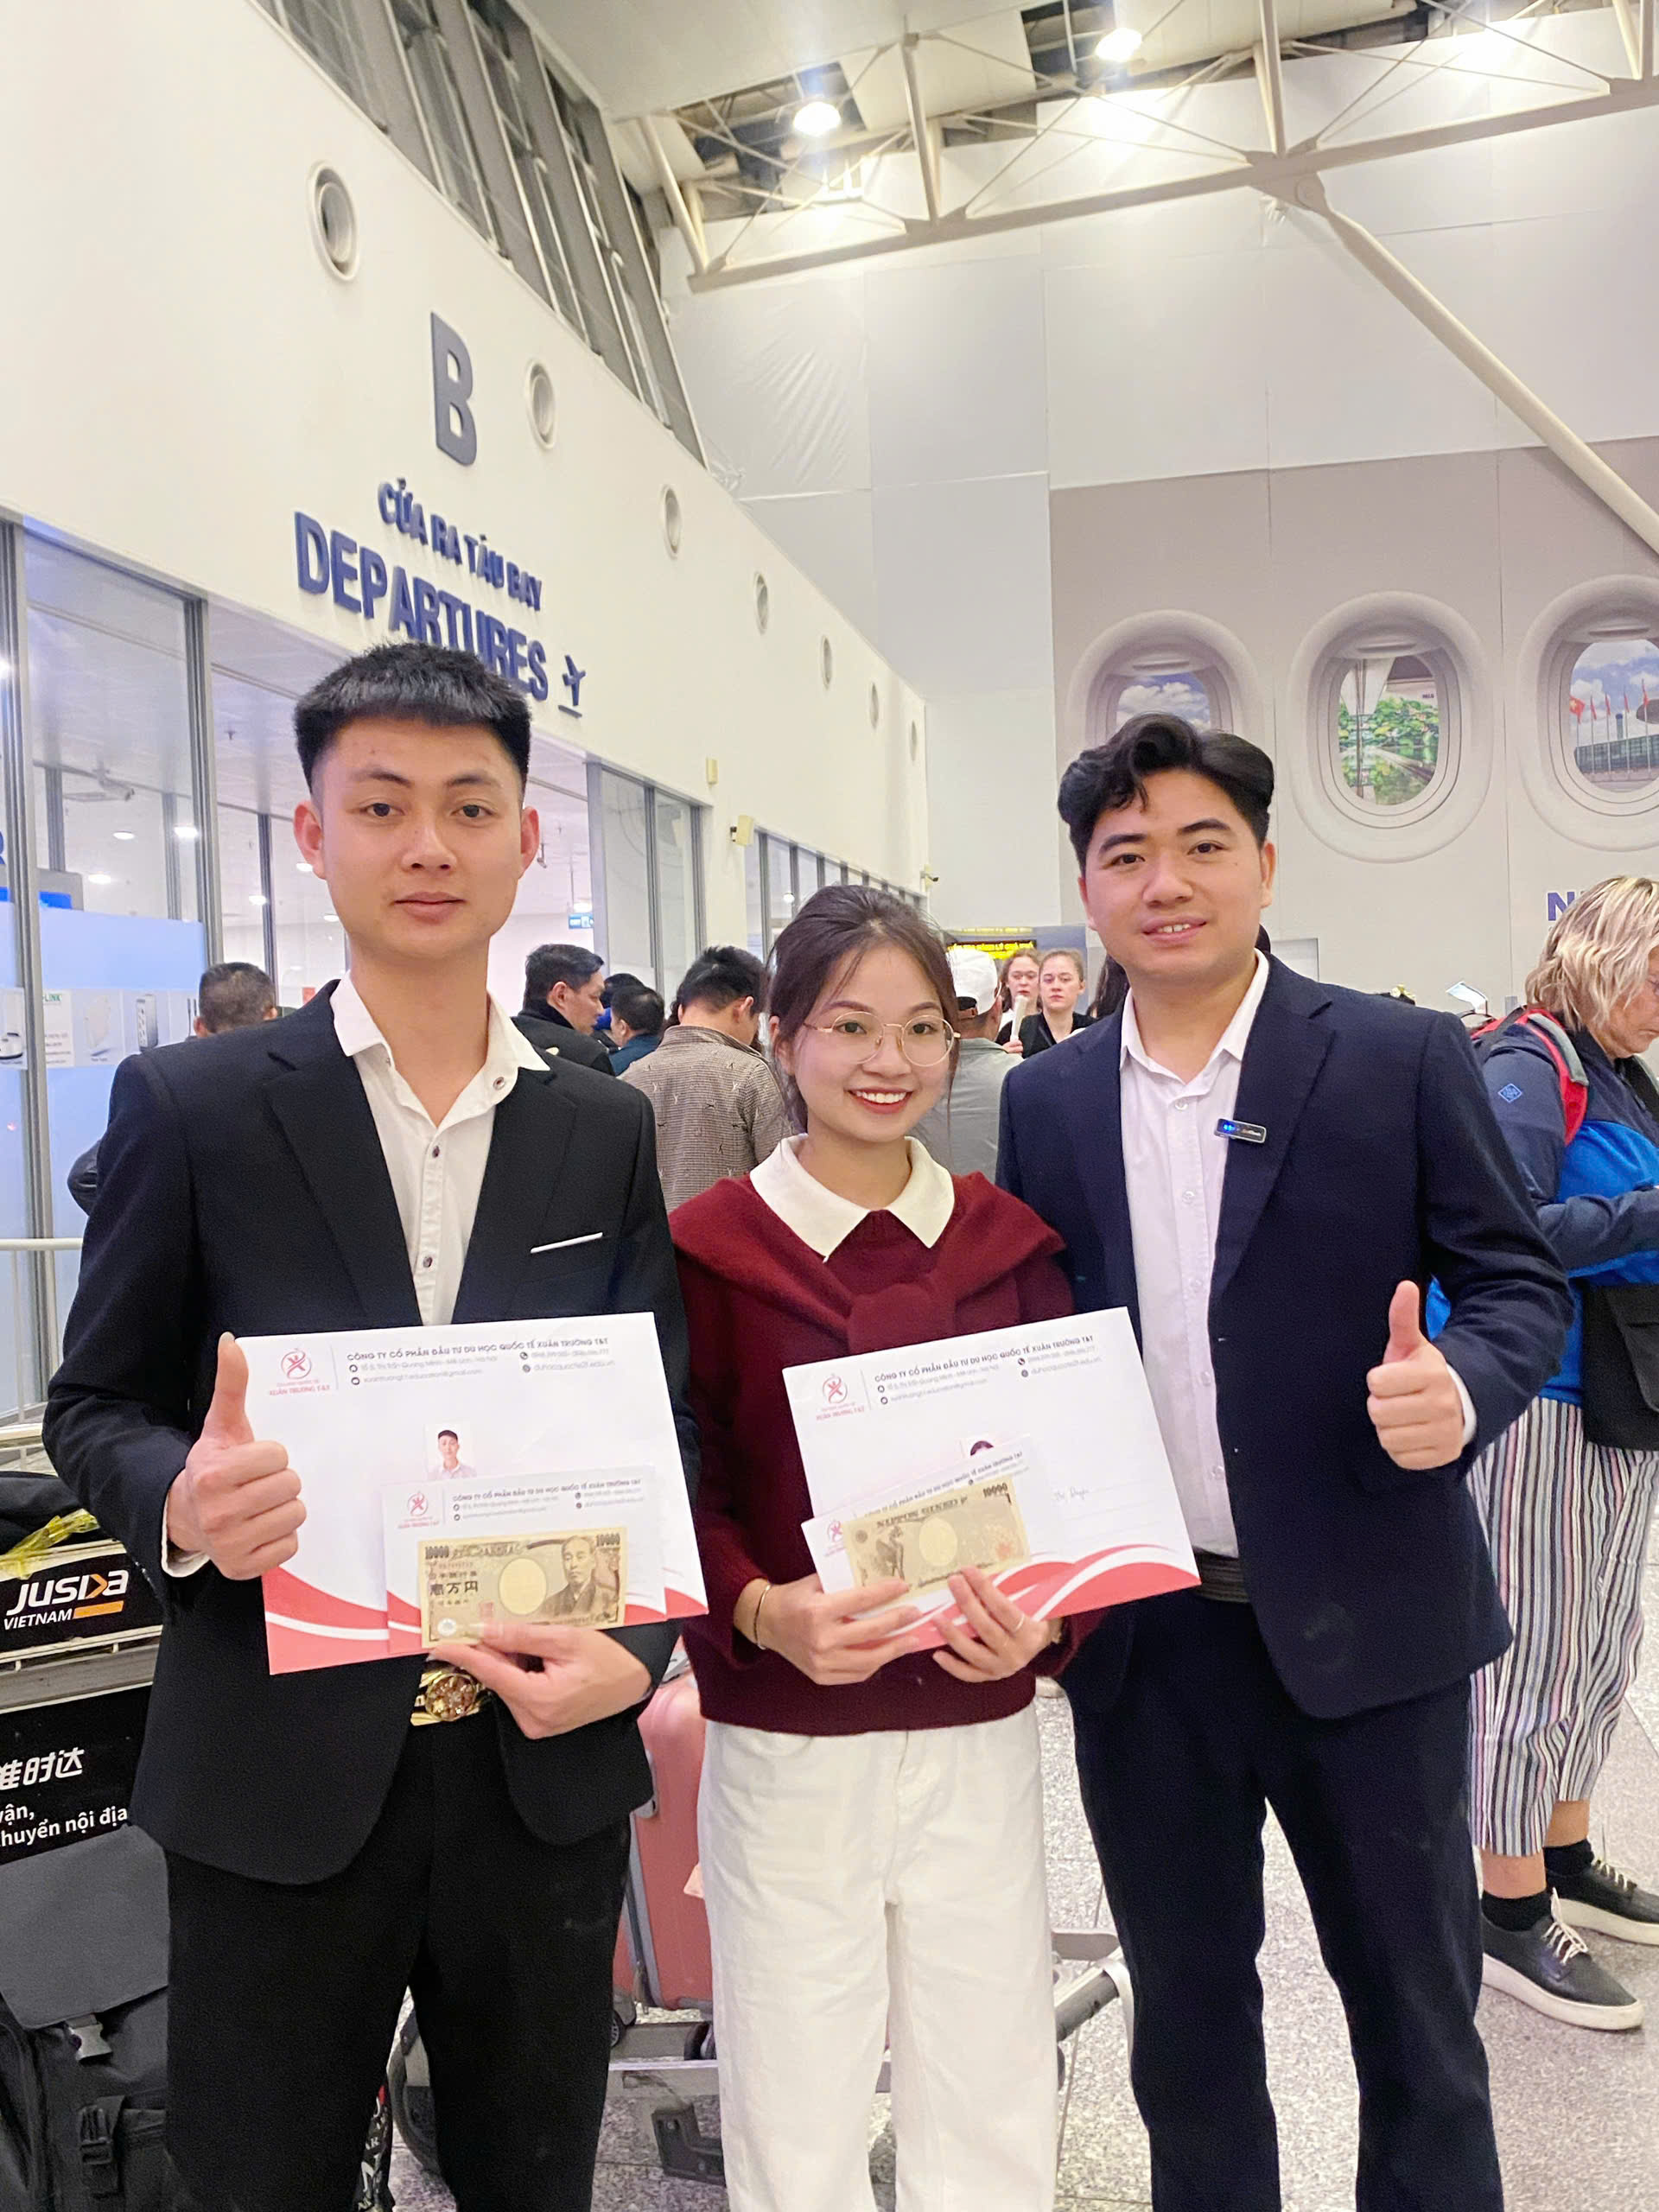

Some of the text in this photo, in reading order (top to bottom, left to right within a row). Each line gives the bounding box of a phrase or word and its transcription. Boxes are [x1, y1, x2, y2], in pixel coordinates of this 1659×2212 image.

[431, 312, 477, 466] B
[378, 478, 542, 611] CỬA RA TÀU BAY
[295, 512, 548, 701] DEPARTURES
[347, 1351, 375, 1361] CÔNG
[874, 1373, 898, 1382] CÔNG
[3, 1608, 73, 1630] VIETNAM
[0, 1806, 128, 1847] huyển nội địa
